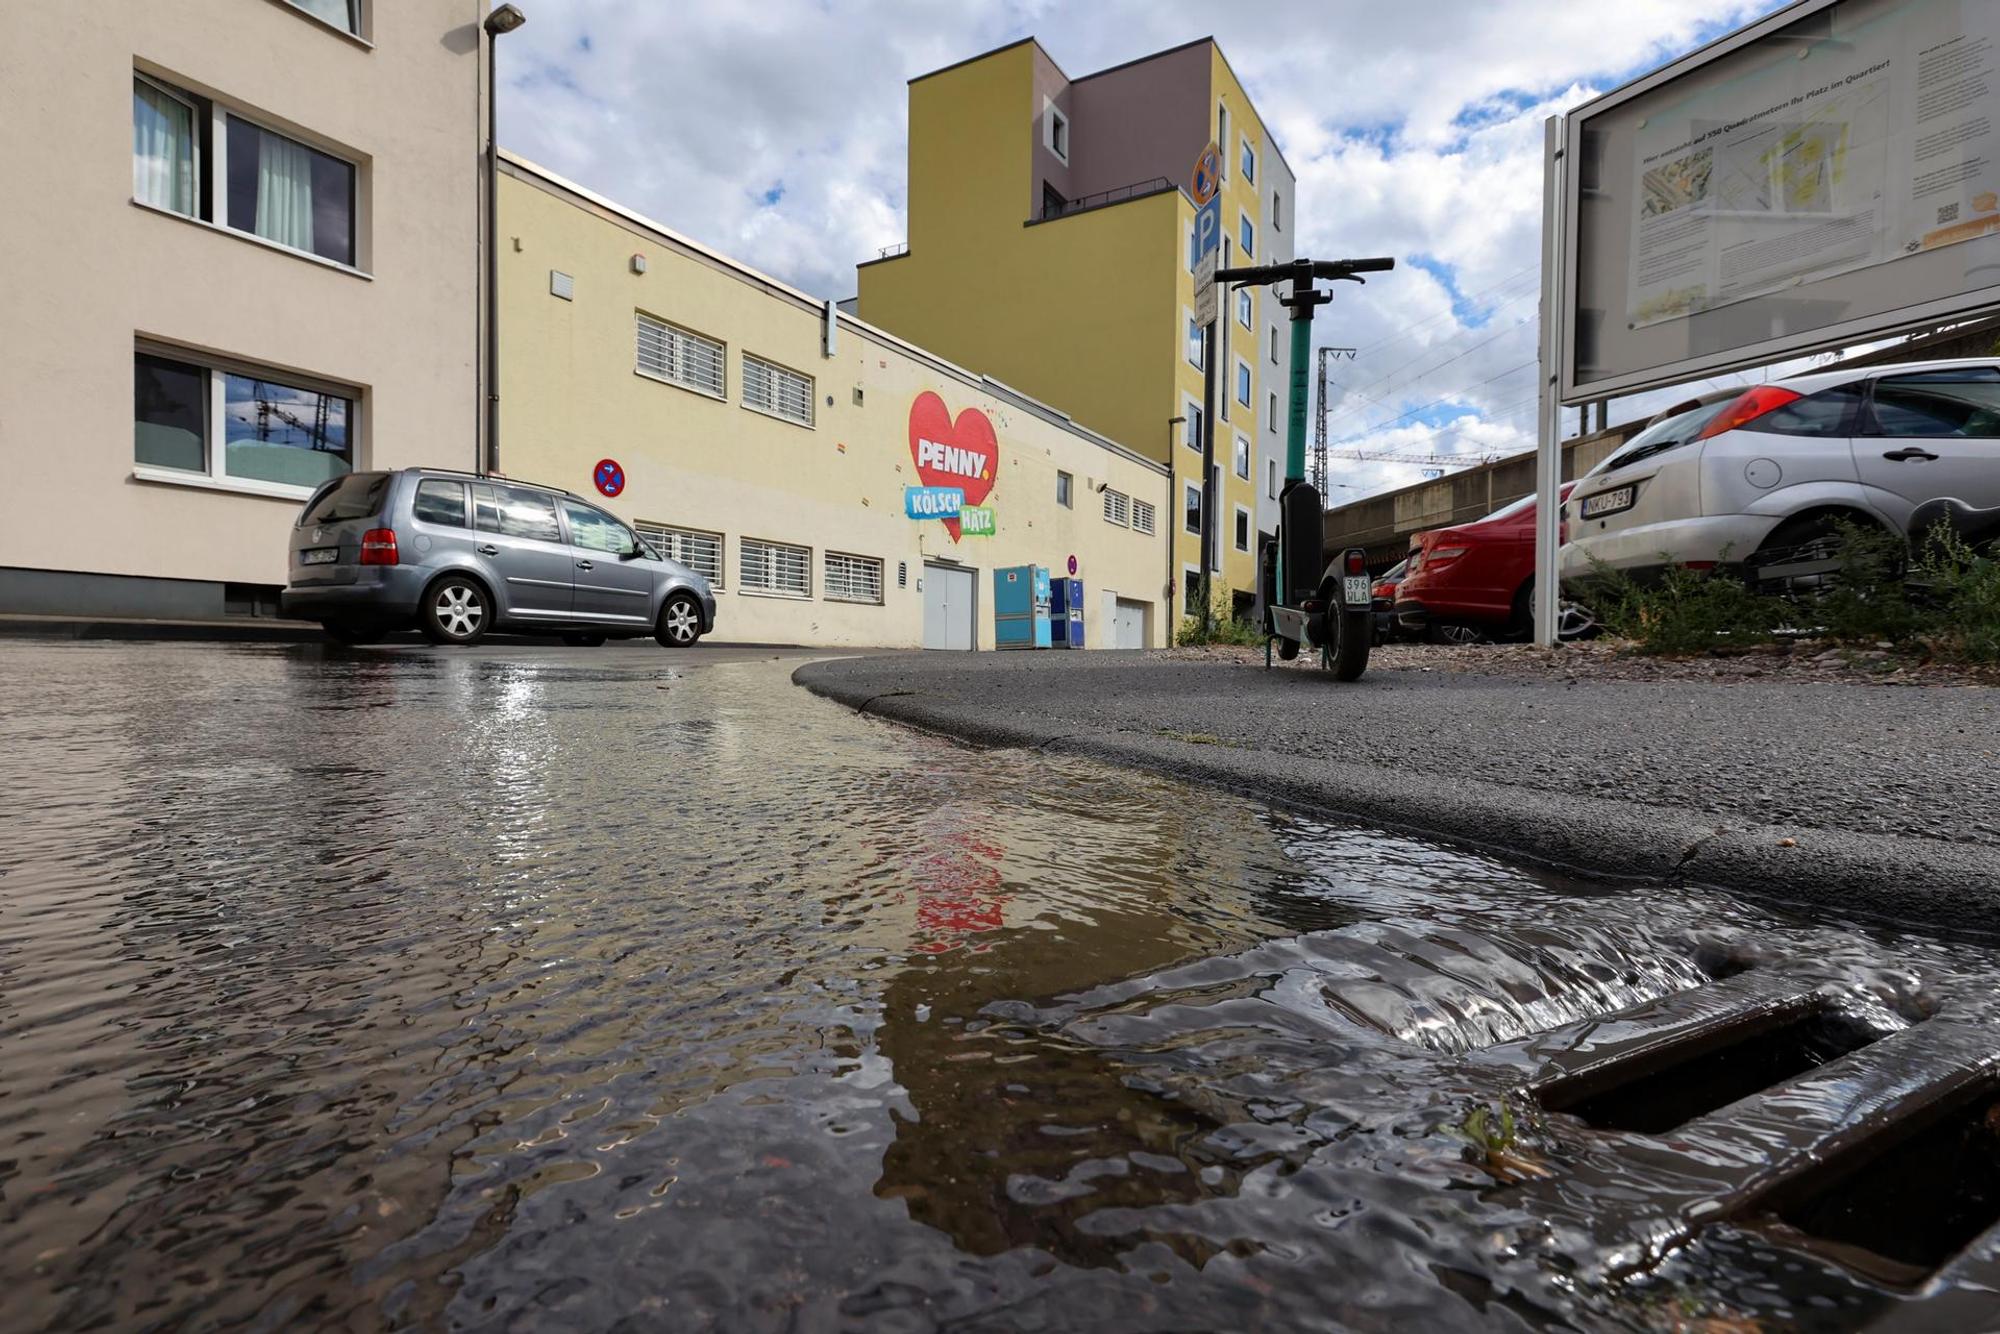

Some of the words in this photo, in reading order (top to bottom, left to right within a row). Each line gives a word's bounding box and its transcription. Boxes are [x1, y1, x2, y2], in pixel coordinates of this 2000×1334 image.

[1693, 133, 1706, 145] auf
[1707, 126, 1722, 139] 550
[1790, 96, 1804, 106] Ihr
[1806, 85, 1829, 99] Platz
[1830, 80, 1843, 90] im
[1845, 59, 1890, 84] Quartier!
[1200, 208, 1215, 259] P
[912, 489, 961, 515] KÖLSCH
[1587, 488, 1631, 514] NKU-793
[962, 508, 992, 532] HÄTZ
[1346, 579, 1367, 590] 396
